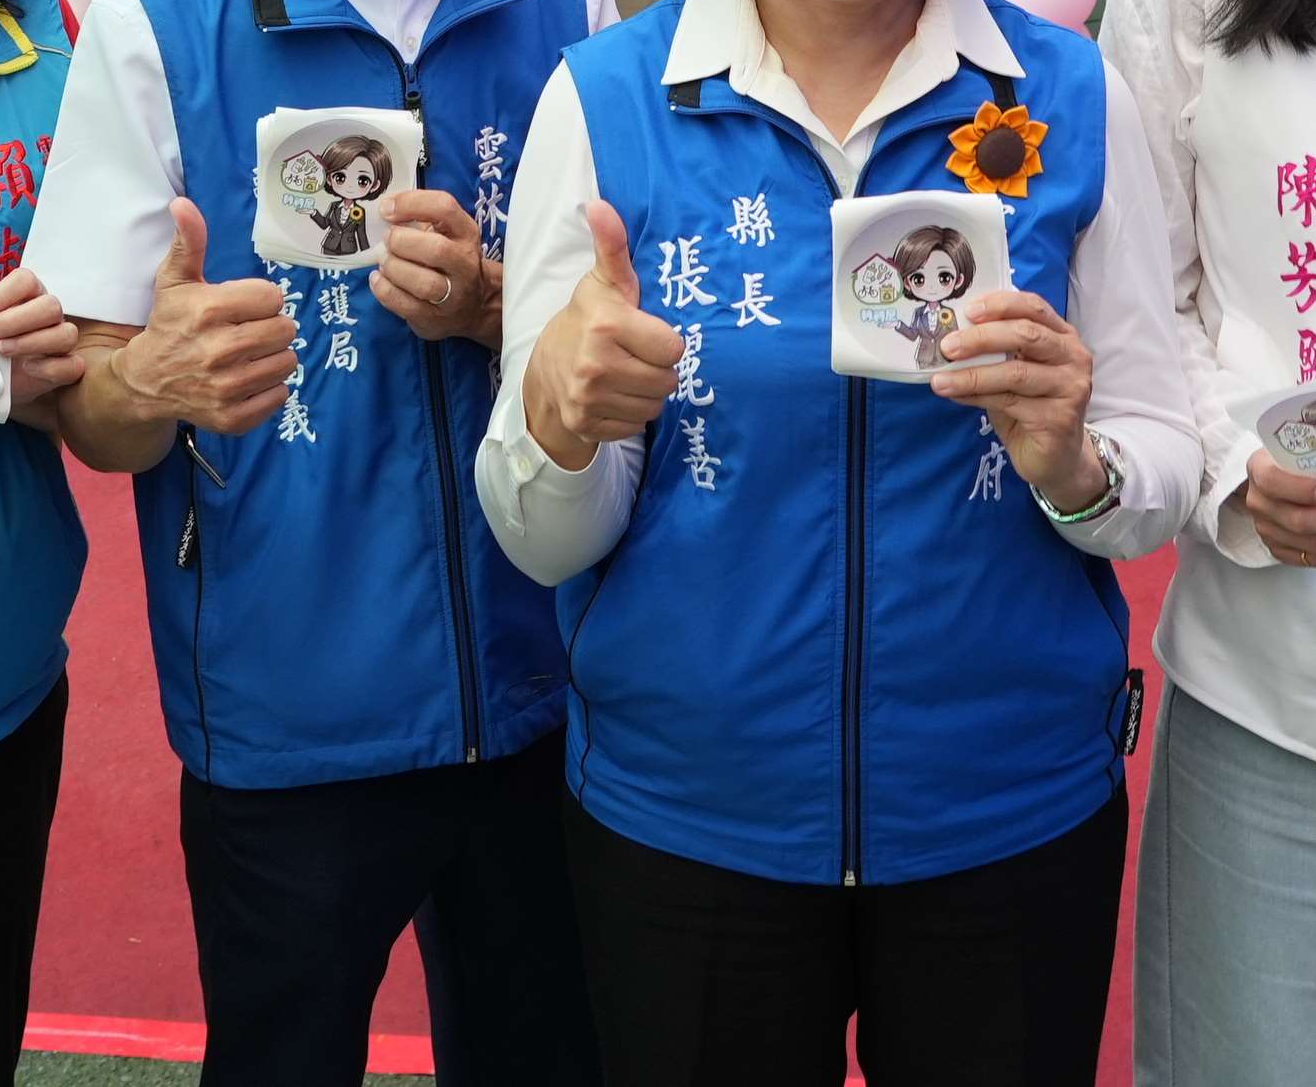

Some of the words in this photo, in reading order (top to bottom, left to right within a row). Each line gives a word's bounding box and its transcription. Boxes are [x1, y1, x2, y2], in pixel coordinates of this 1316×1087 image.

[727, 192, 781, 328] 縣長
[657, 234, 722, 491] 張麗善
